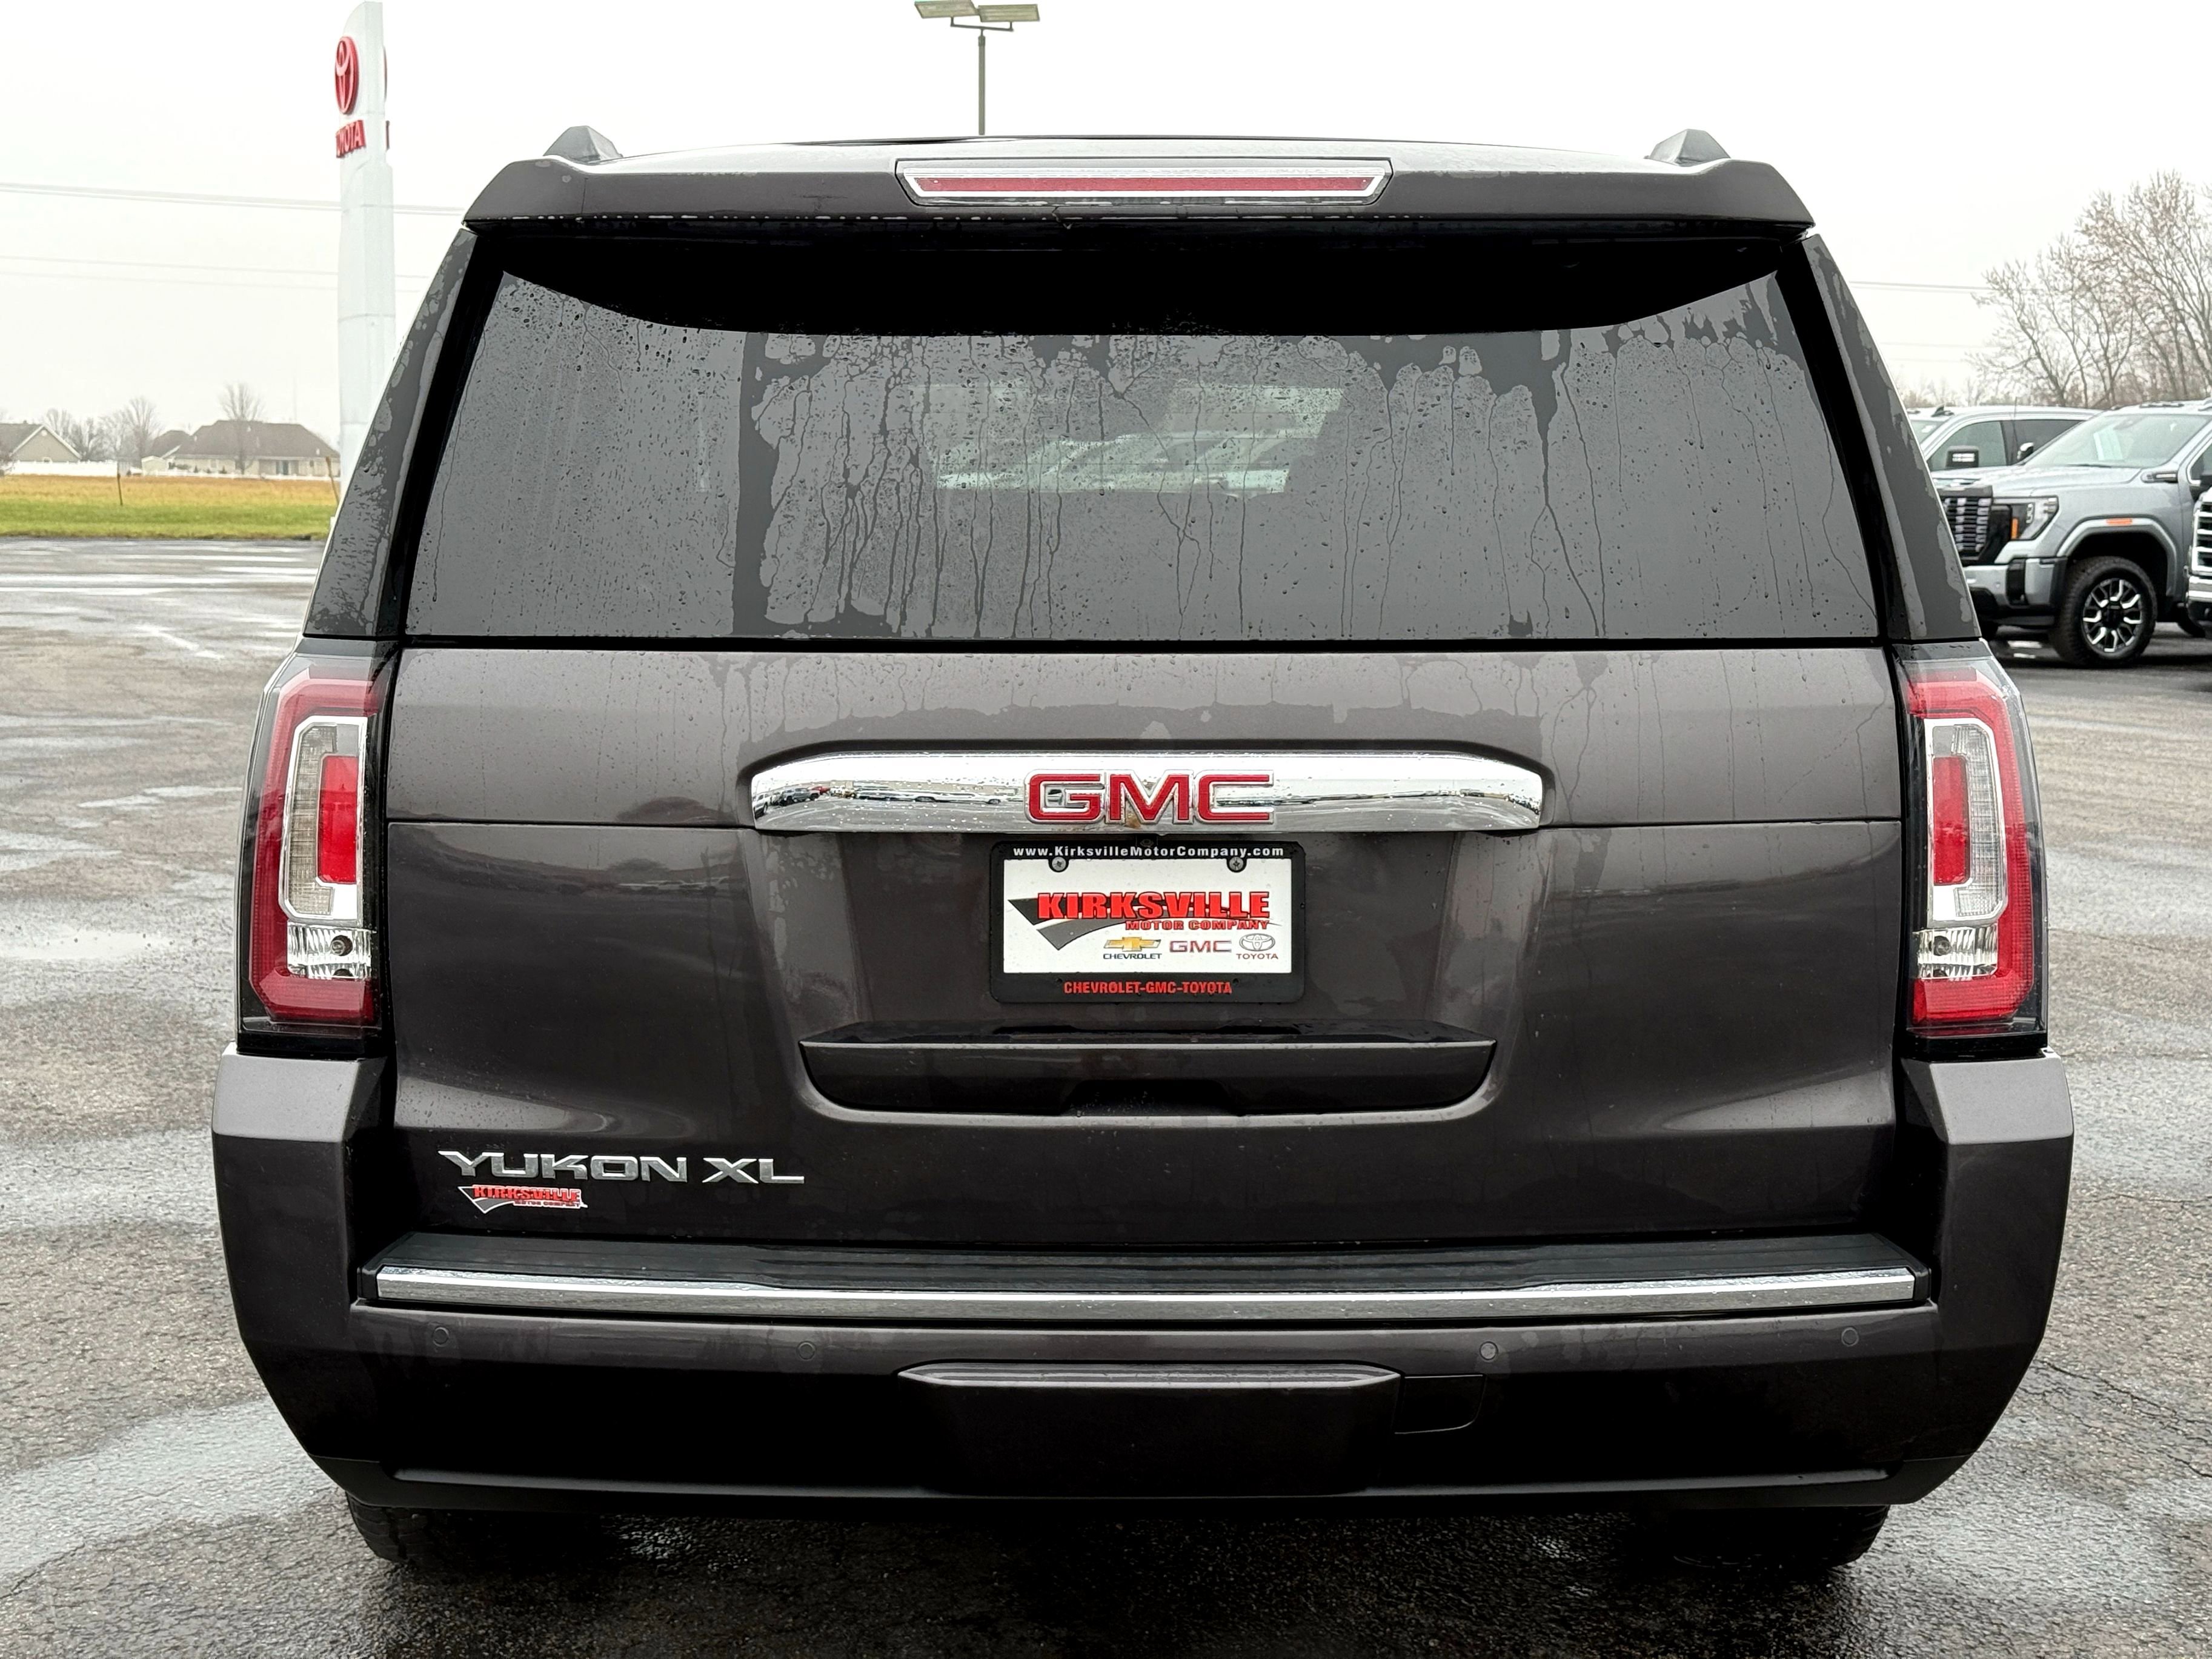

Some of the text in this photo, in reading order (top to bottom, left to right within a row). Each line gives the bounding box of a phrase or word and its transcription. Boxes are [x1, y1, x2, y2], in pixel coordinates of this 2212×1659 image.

[1025, 770, 1274, 825] GMC
[1013, 846, 1284, 857] www.KirksvilleMotorCompany.com
[1037, 892, 1270, 919] KIRKSVILLE
[1125, 920, 1269, 930] MOTOR COMPANY
[1169, 940, 1232, 953] GMC
[1063, 982, 1232, 994] CHEVROLET-GMC-TOYOTA
[438, 1151, 805, 1183] YUKON XL
[474, 1186, 580, 1201] KIRKSVILLE
